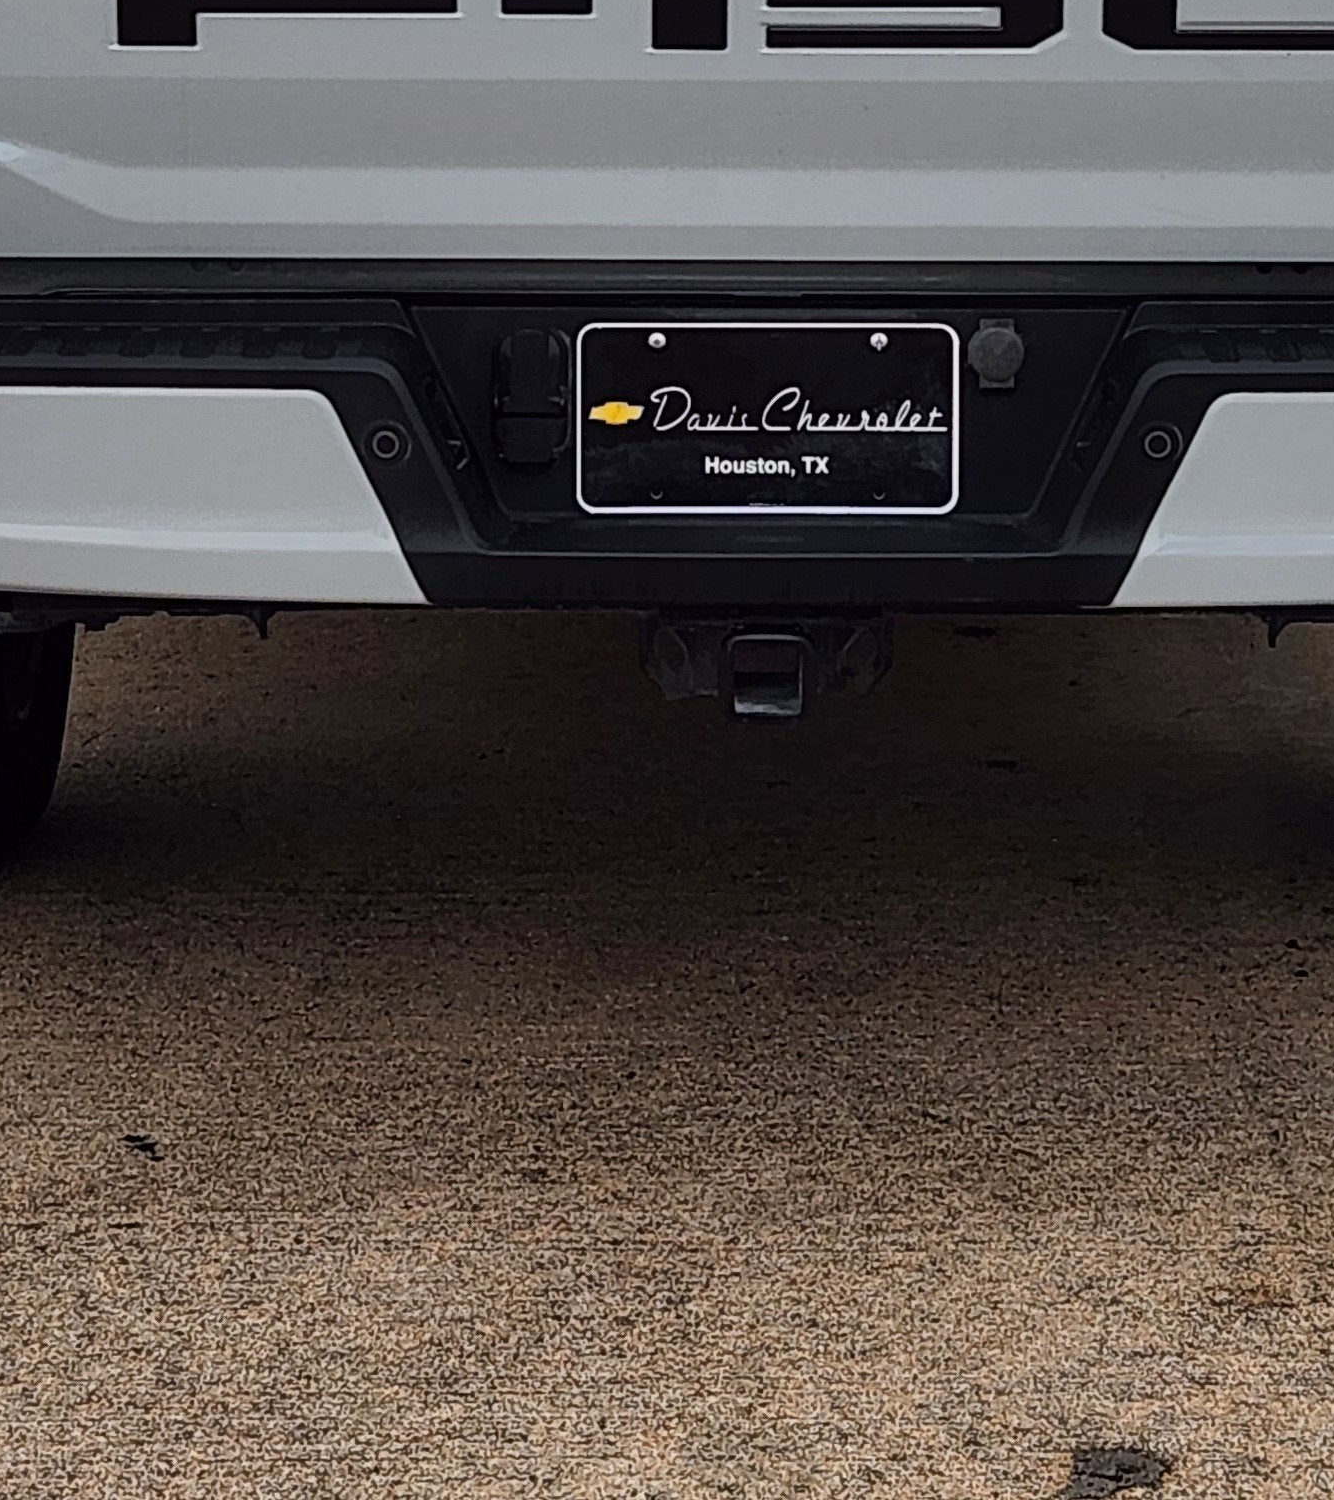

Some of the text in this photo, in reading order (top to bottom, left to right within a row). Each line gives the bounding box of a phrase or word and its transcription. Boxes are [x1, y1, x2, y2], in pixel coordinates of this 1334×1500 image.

[650, 386, 948, 431] Davis Chevrolet
[704, 456, 829, 477] Houston, TX
